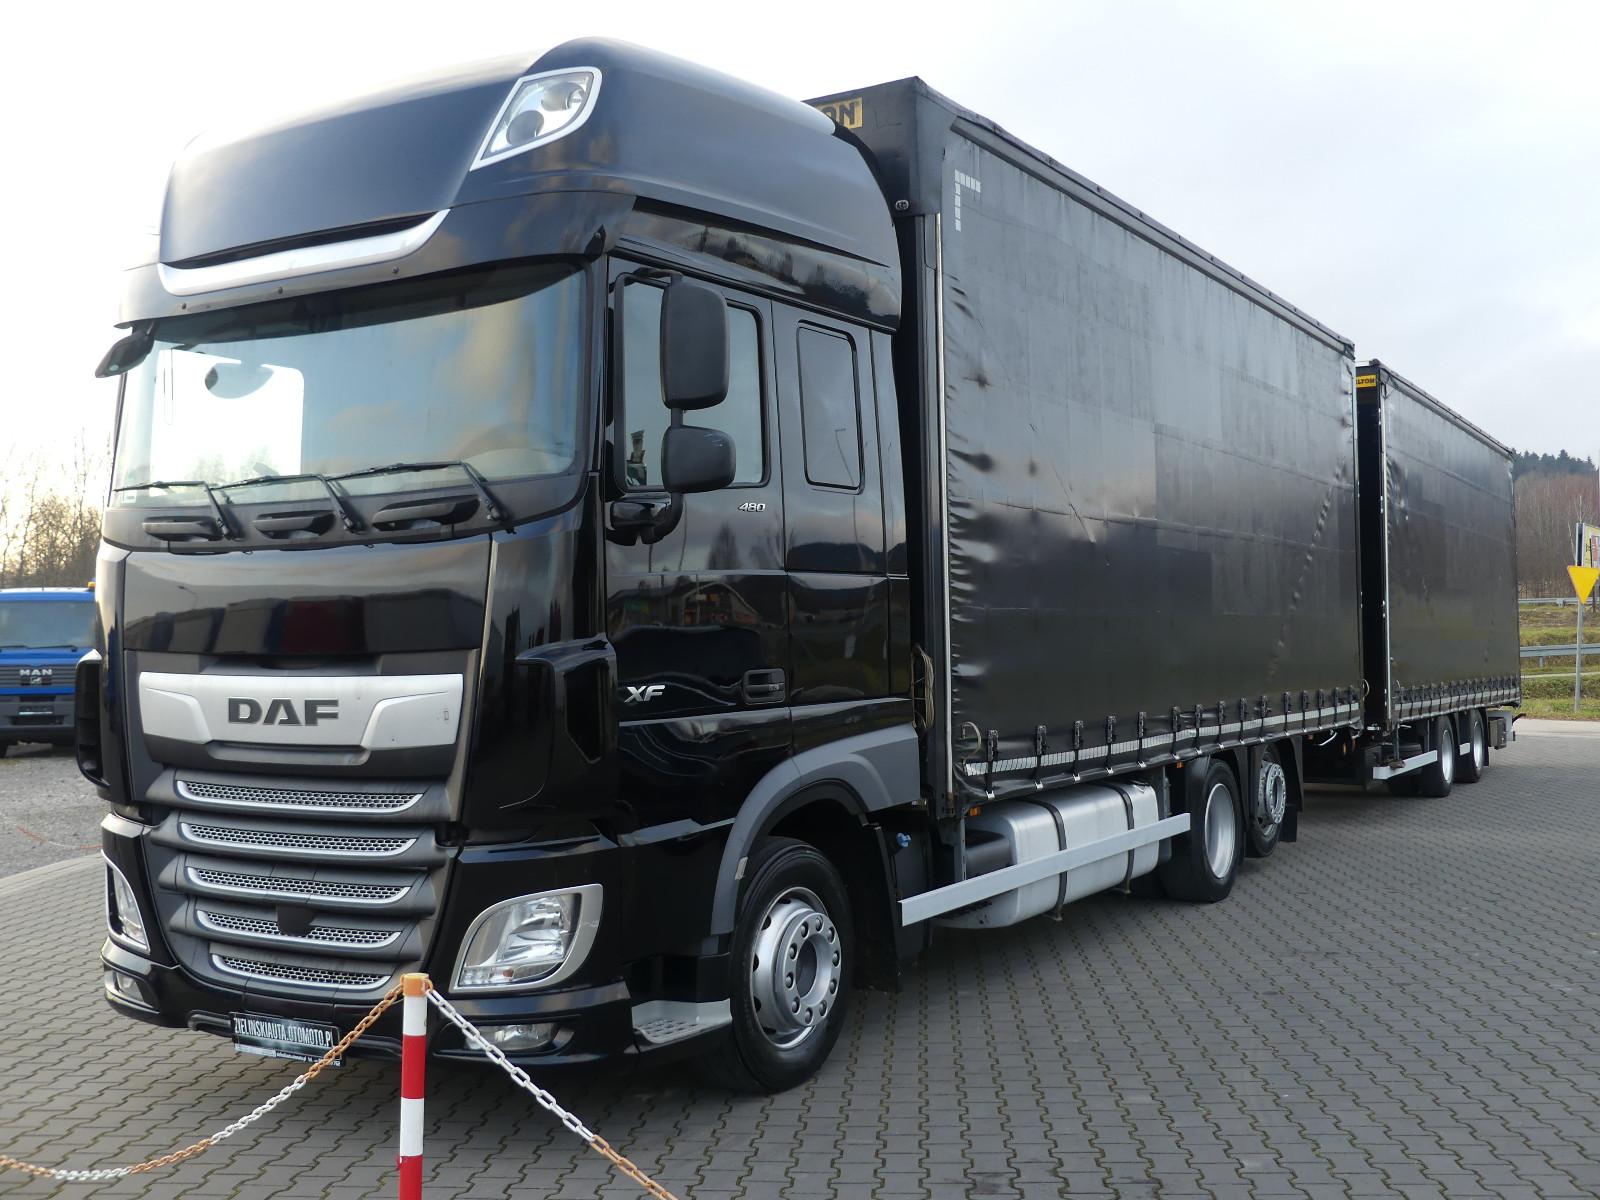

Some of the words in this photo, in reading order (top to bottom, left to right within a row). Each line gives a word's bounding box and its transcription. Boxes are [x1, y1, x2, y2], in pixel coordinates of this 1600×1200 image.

[738, 502, 766, 512] 480
[624, 685, 666, 703] XF
[228, 698, 339, 726] DAF
